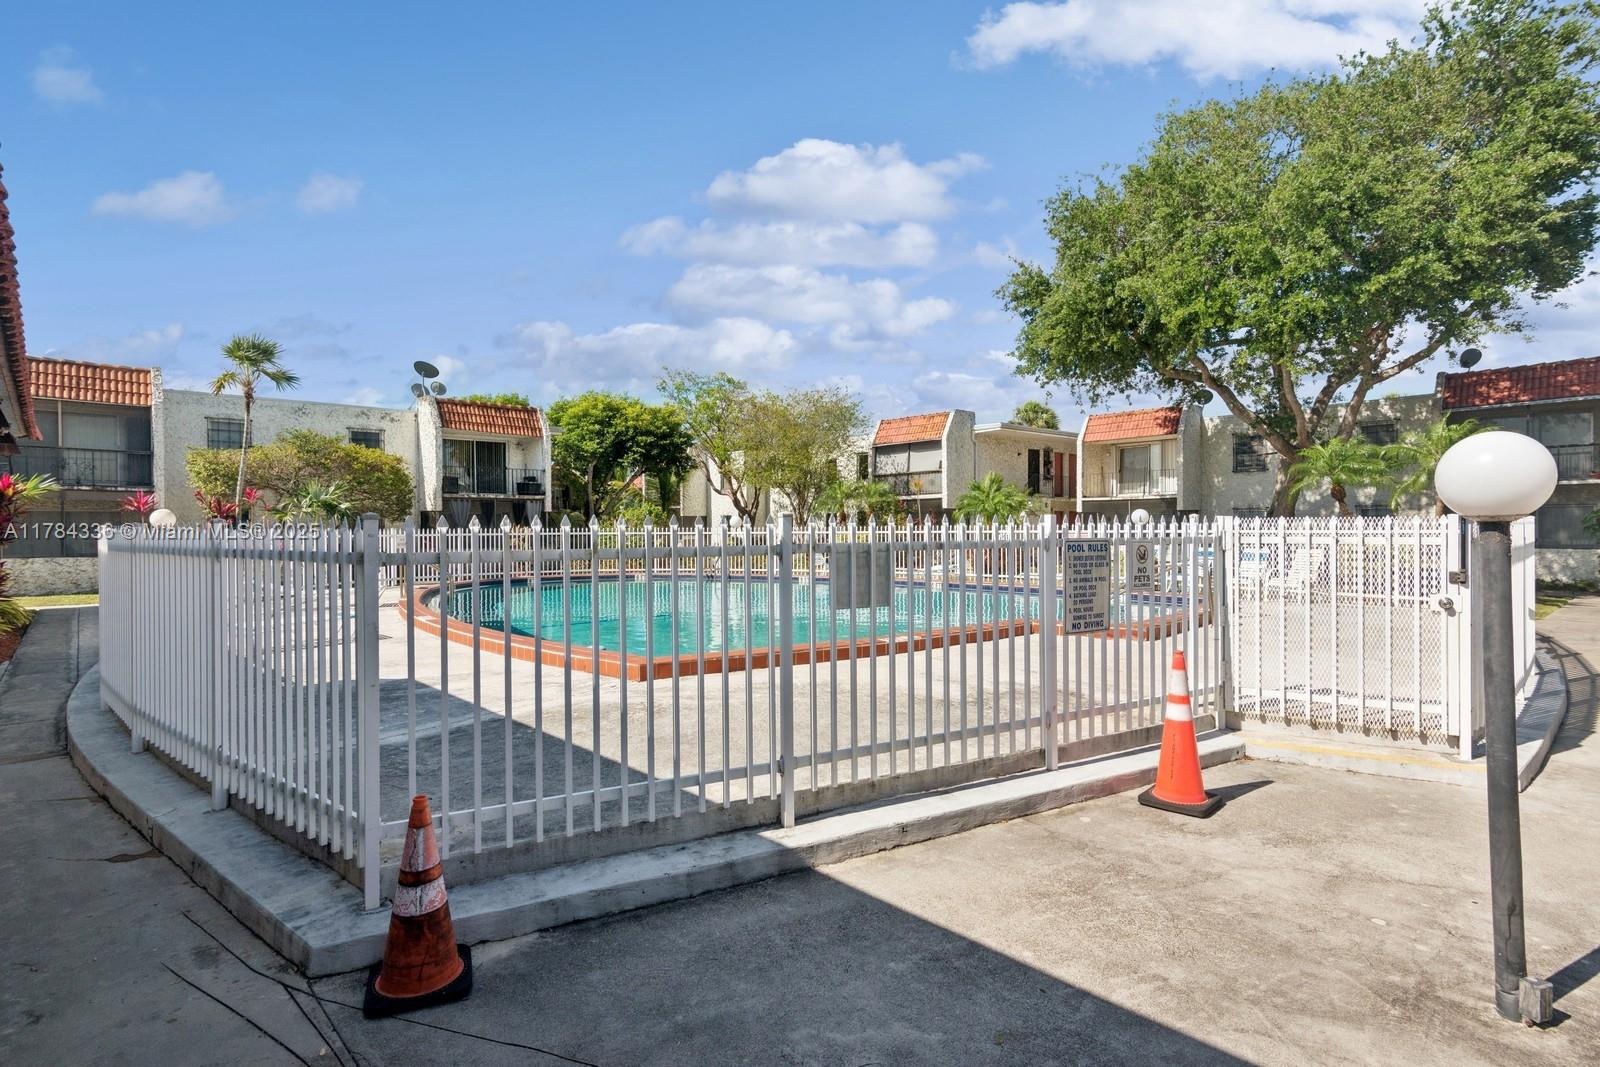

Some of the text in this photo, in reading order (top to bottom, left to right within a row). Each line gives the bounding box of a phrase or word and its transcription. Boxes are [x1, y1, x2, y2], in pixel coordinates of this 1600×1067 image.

[1067, 544, 1108, 552] POOL RULES
[1072, 620, 1104, 630] NO DIVING
